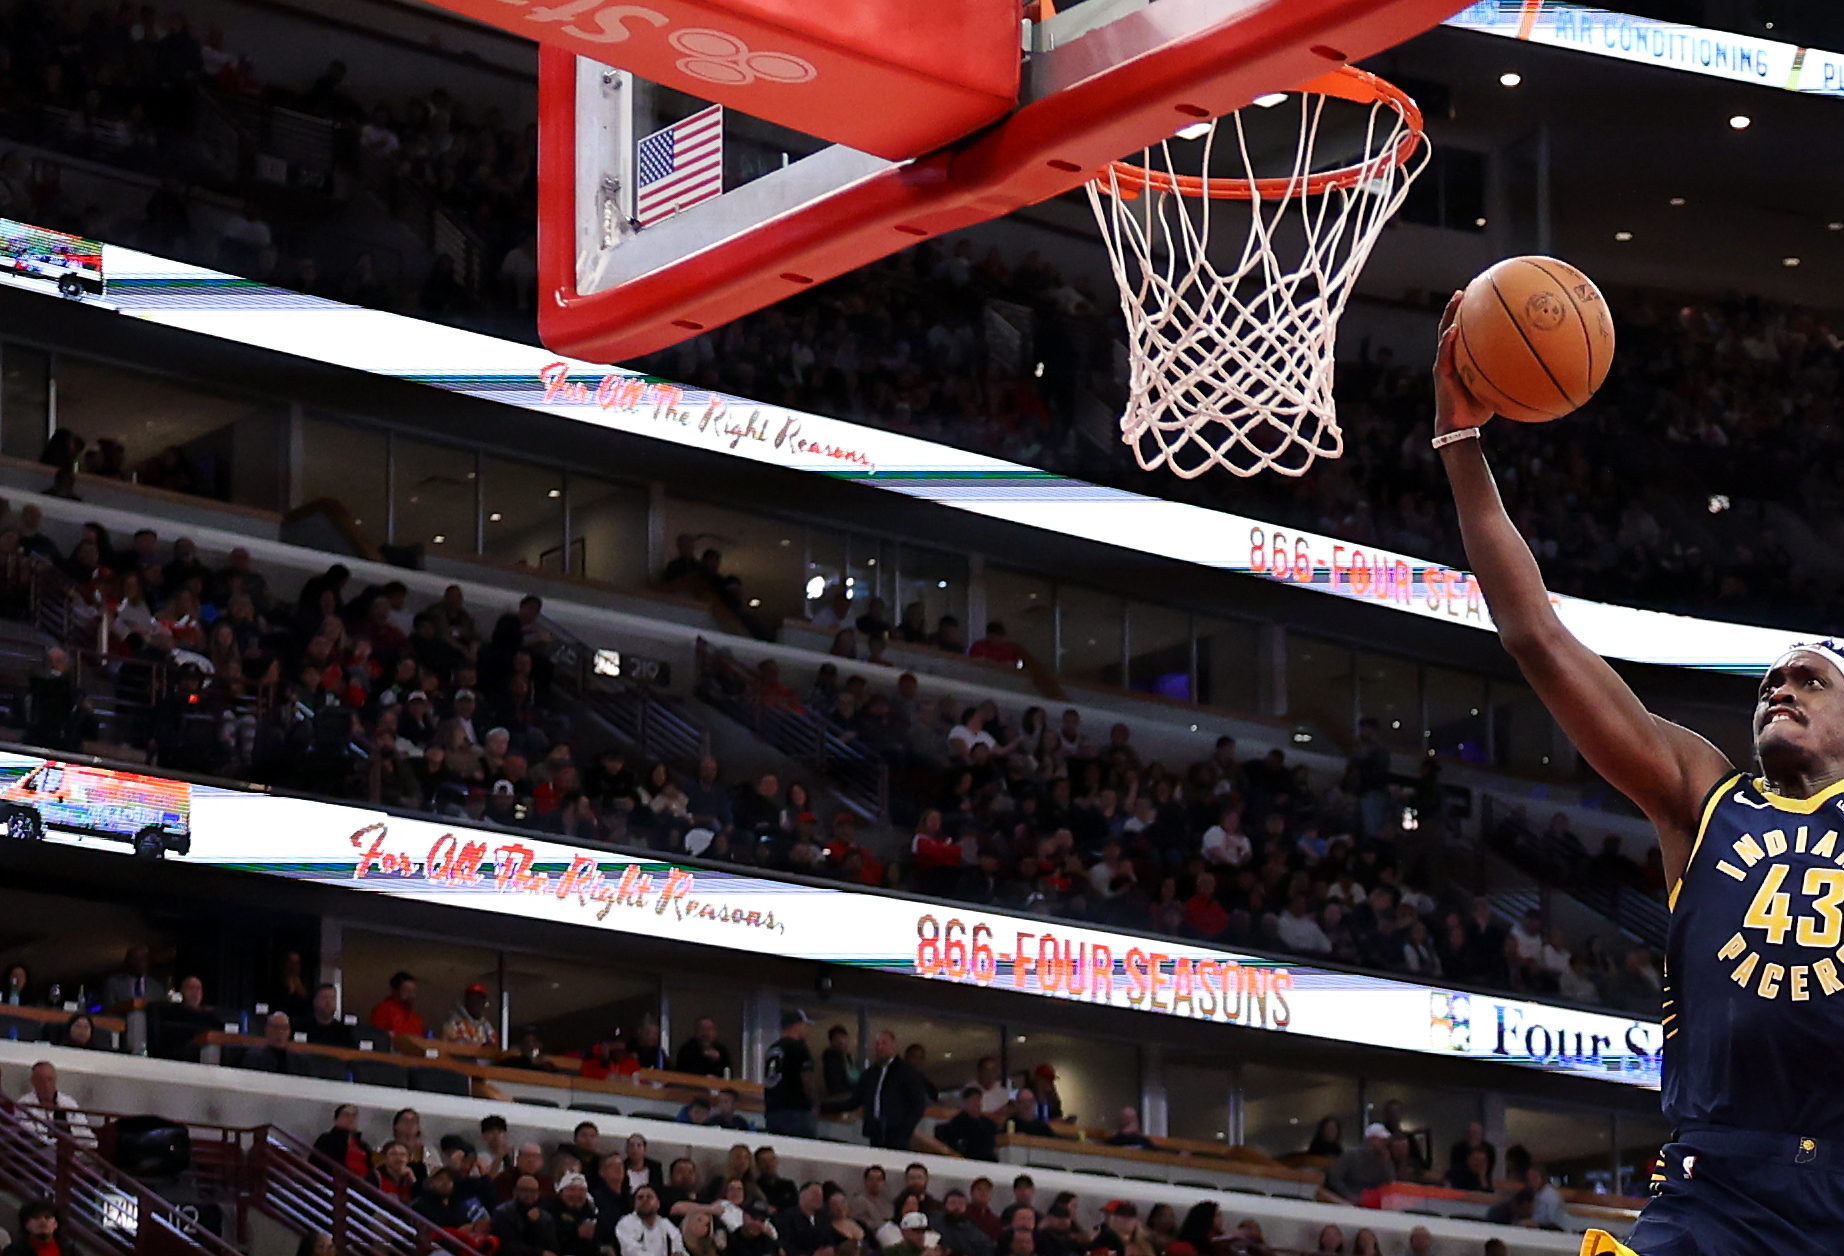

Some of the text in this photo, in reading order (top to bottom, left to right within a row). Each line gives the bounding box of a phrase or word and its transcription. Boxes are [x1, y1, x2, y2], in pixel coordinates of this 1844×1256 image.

[1602, 18, 1769, 77] CONDITIONING
[539, 361, 589, 403] For
[648, 381, 693, 428] The
[700, 391, 770, 449] Right
[1250, 527, 1414, 606] 866-FOUR
[350, 823, 417, 879] For
[556, 853, 650, 921] Right
[906, 913, 1293, 1030] 866-FOUR SEASONS
[1491, 1004, 1611, 1067] Four
